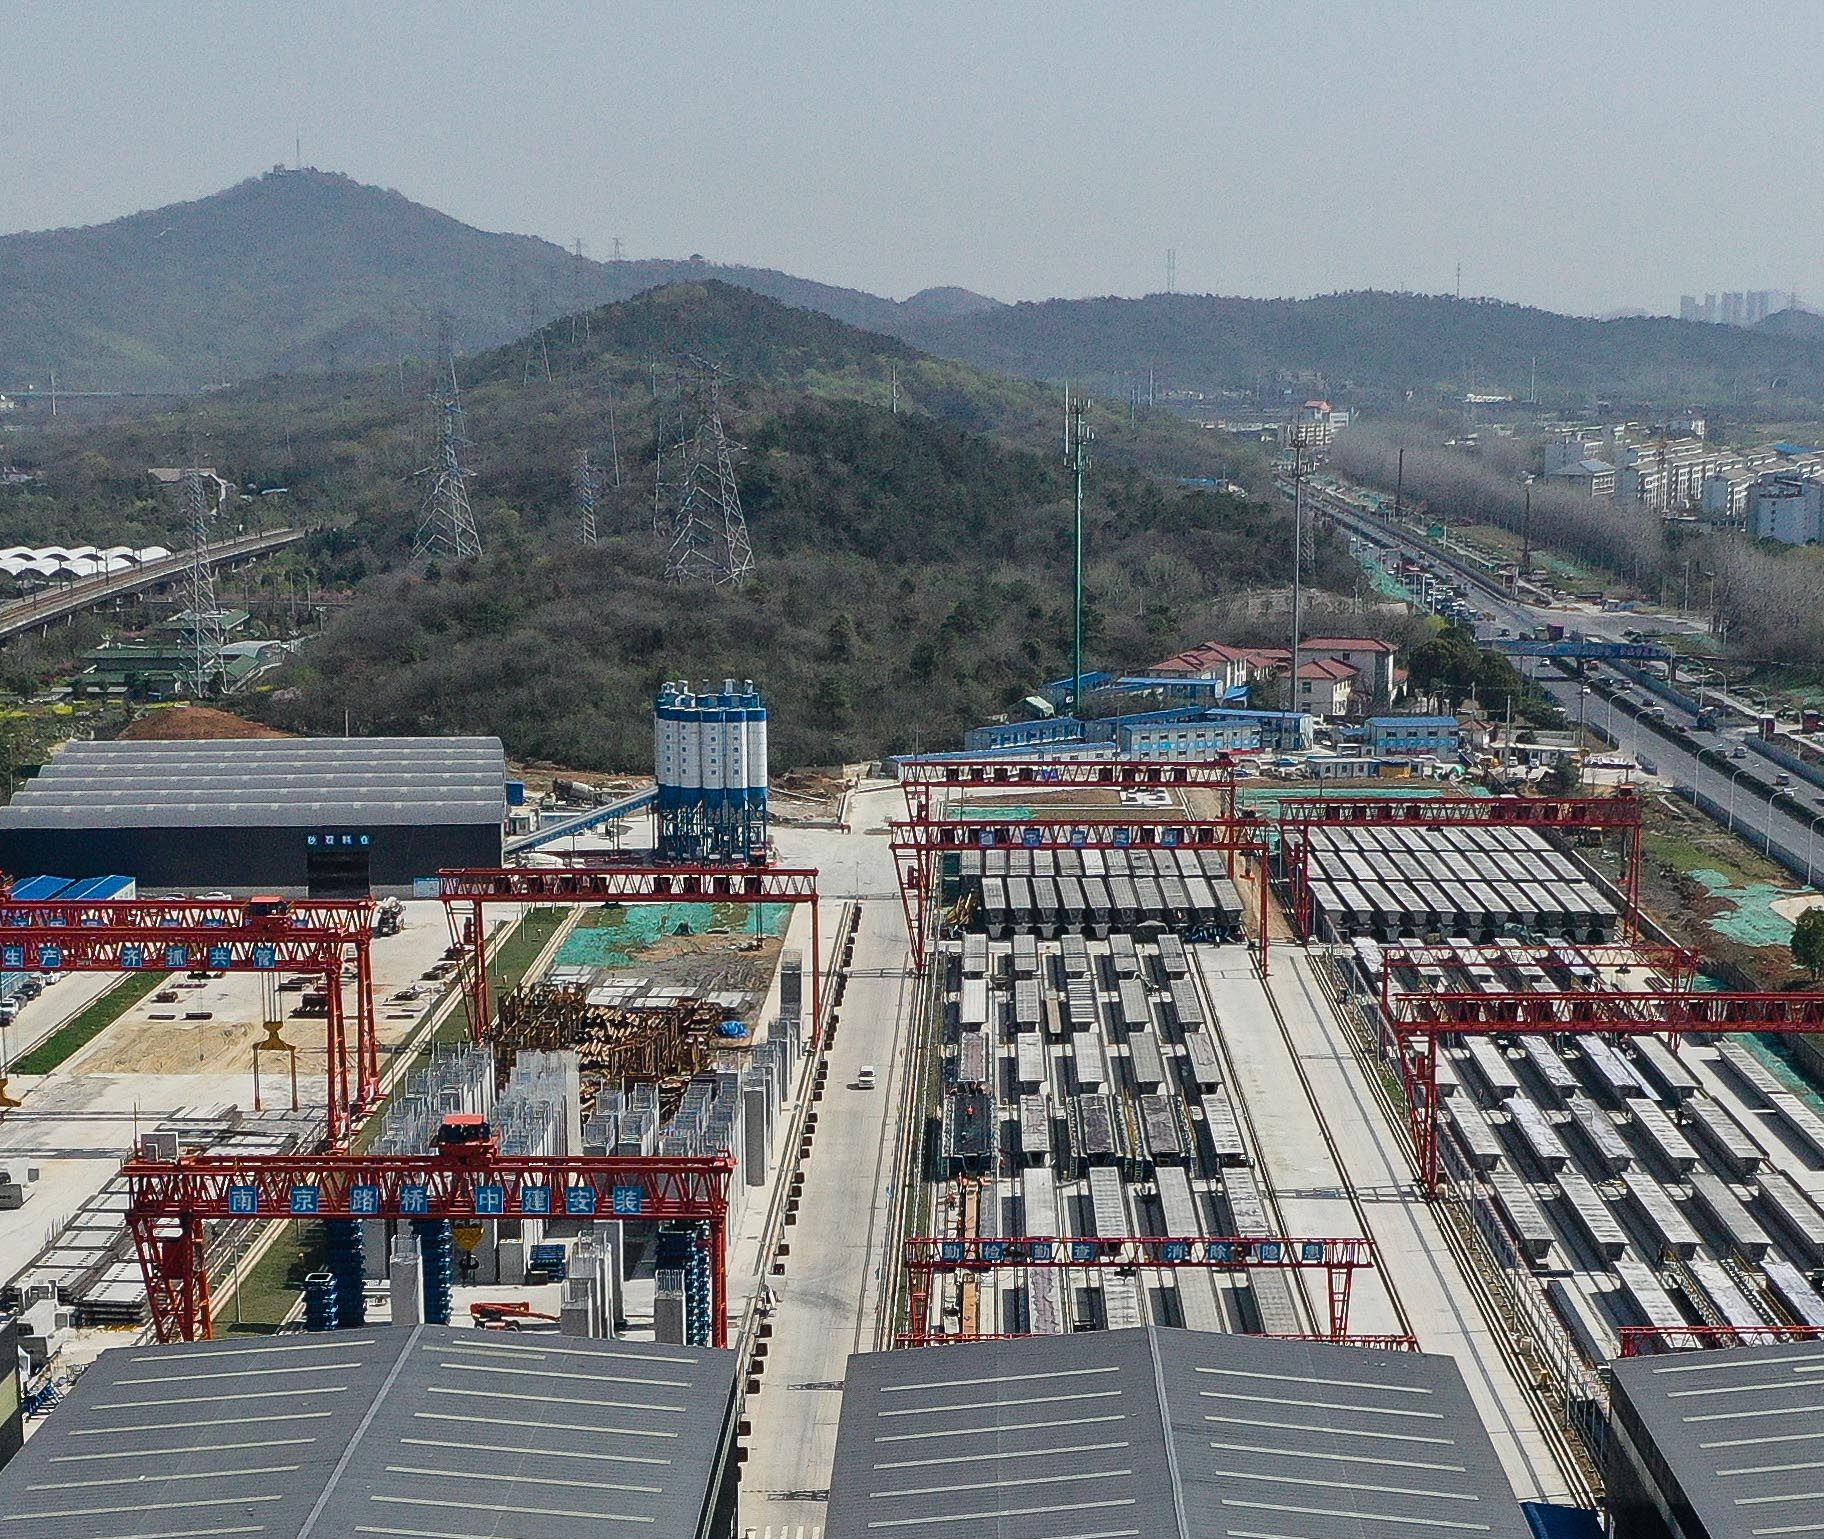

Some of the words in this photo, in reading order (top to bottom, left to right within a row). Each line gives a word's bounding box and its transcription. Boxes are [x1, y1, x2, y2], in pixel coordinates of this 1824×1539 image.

[123, 947, 275, 968] 齐抓共管
[231, 1187, 426, 1214] 南京路桥
[478, 1187, 641, 1214] 中建安装
[1167, 1244, 1322, 1261] 消除隐患
